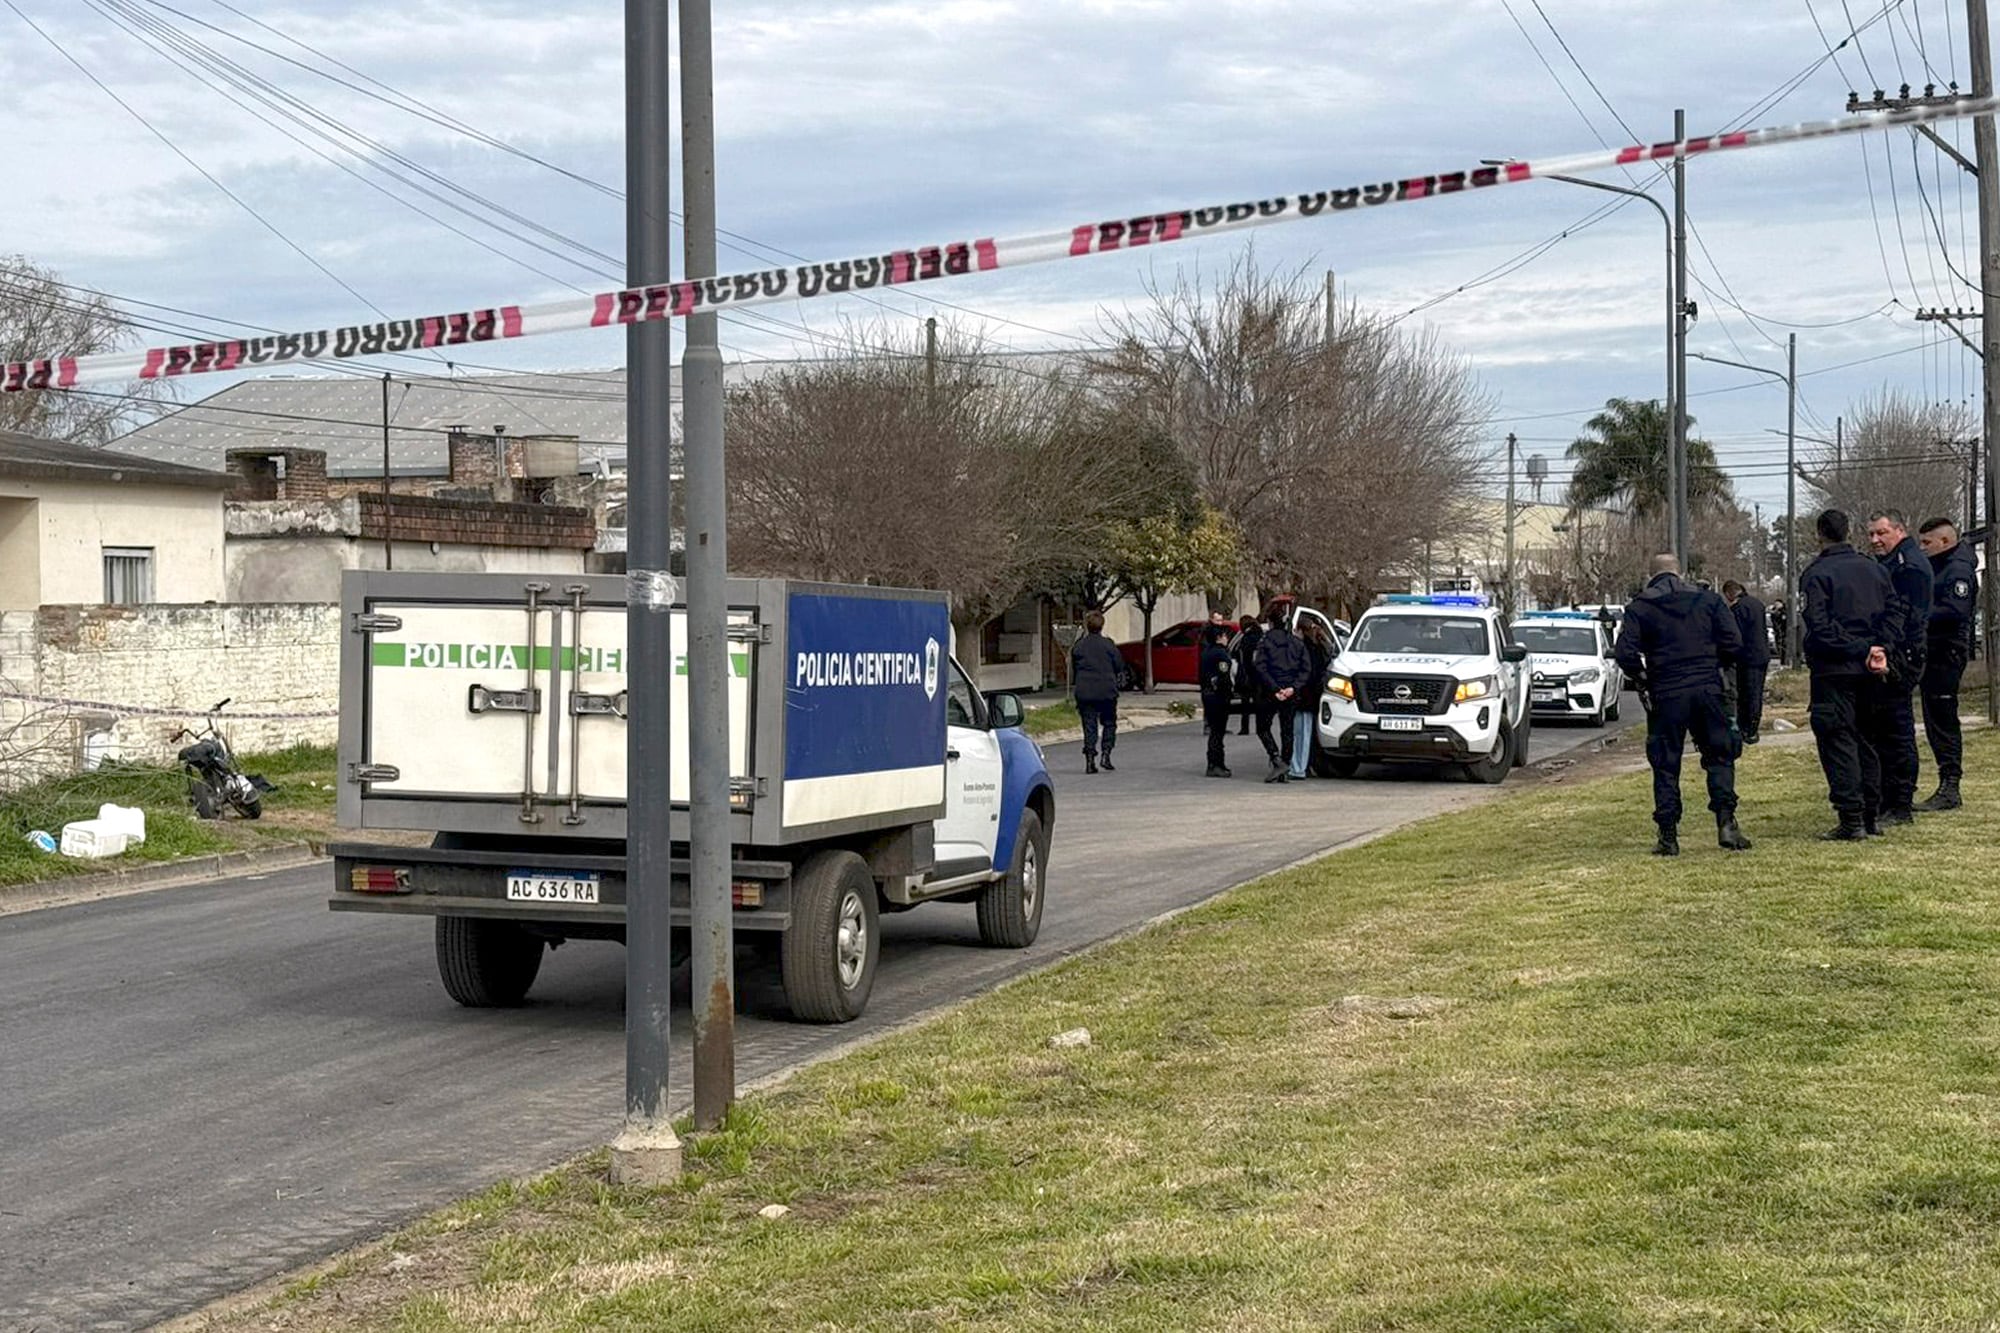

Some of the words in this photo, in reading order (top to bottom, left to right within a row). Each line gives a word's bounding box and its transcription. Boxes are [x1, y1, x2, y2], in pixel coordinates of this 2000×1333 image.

[404, 644, 518, 669] POLICIA
[796, 652, 852, 687] POLICIA
[854, 652, 921, 686] CIENTIFICA
[512, 880, 532, 897] AC
[538, 881, 568, 899] 636
[574, 882, 595, 900] RA
